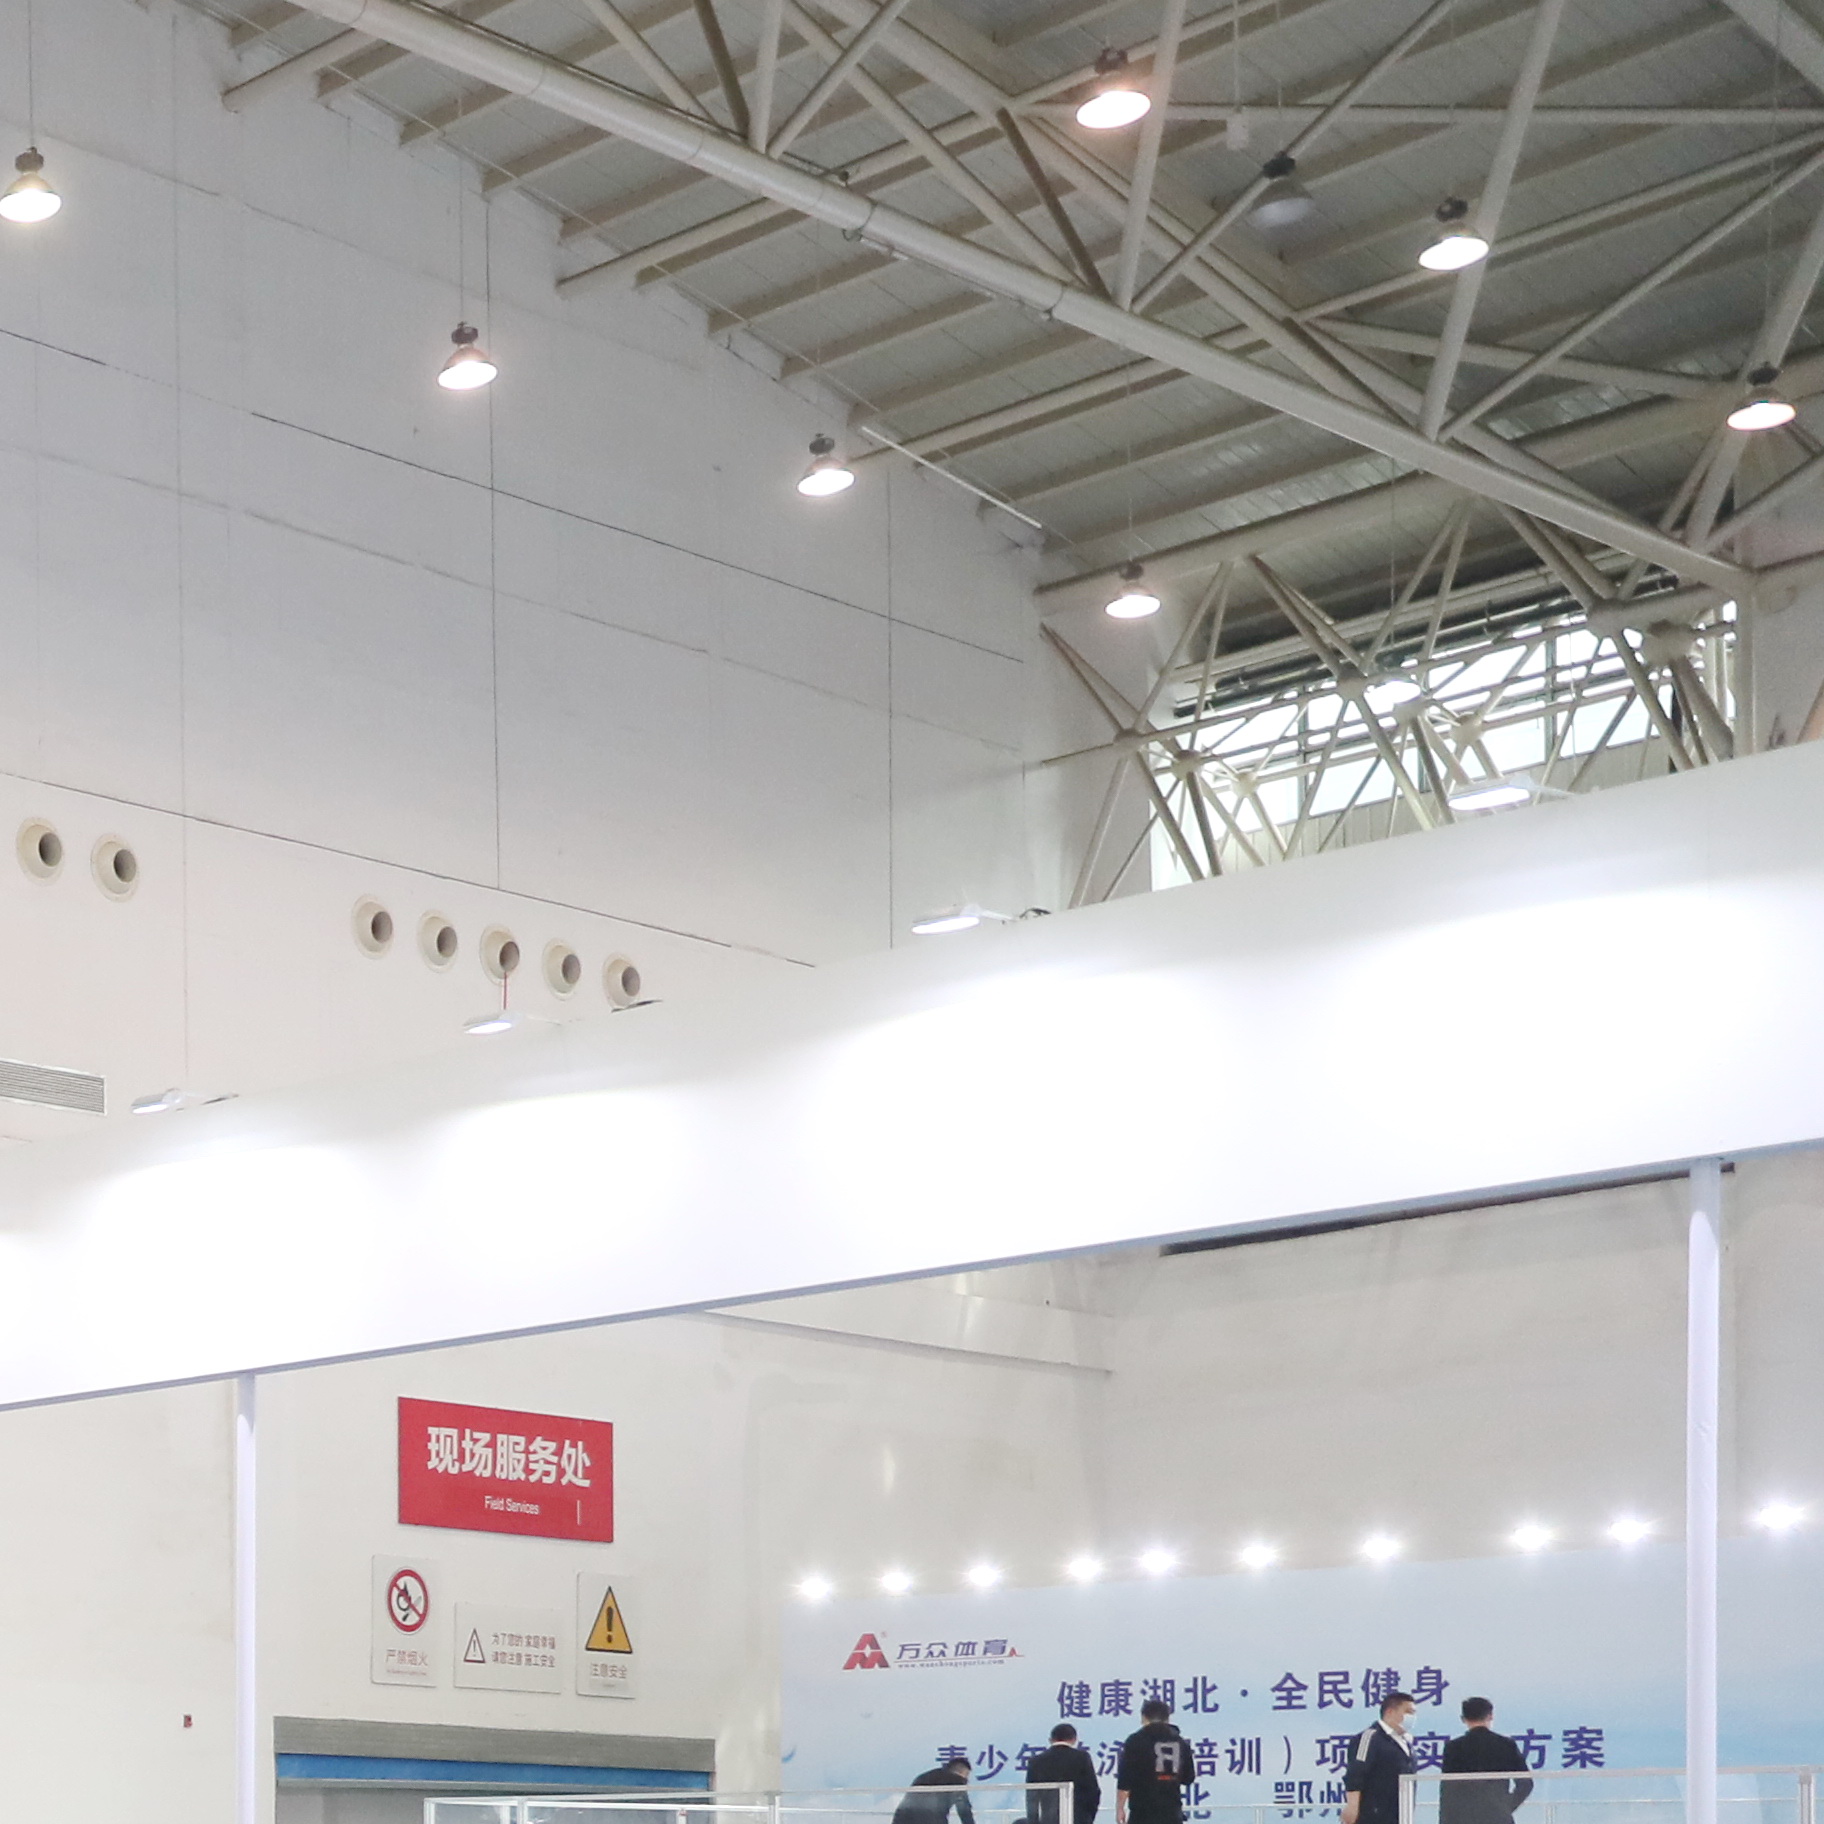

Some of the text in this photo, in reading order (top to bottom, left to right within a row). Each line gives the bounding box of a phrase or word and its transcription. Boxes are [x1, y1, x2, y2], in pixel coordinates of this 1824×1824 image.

[426, 1425, 592, 1488] 现场服务处
[483, 1495, 540, 1515] Field Services
[896, 1638, 1009, 1660] 万众体育
